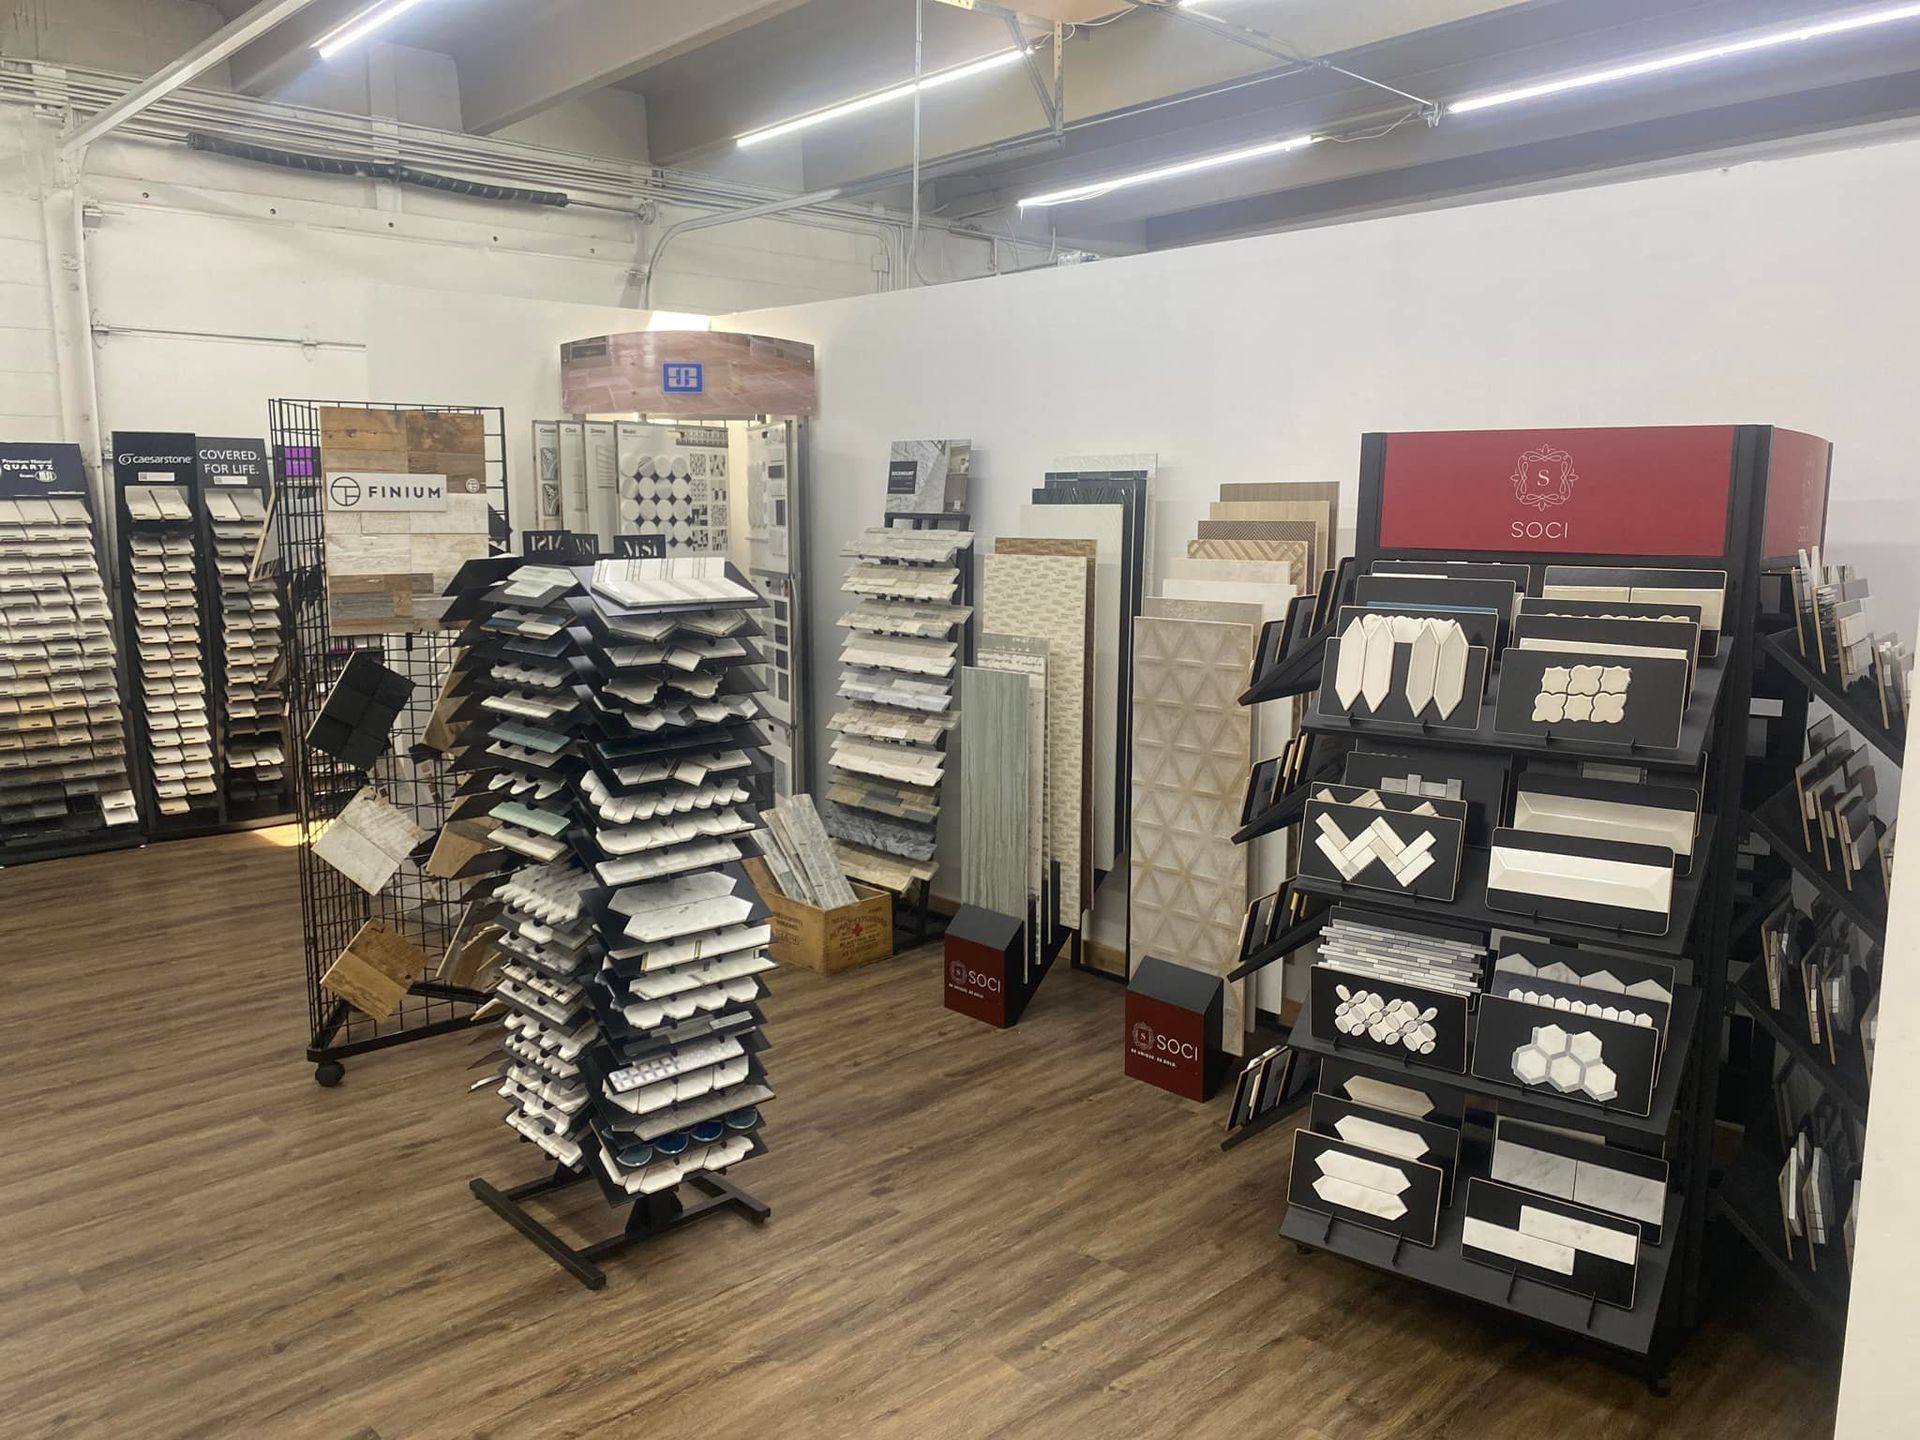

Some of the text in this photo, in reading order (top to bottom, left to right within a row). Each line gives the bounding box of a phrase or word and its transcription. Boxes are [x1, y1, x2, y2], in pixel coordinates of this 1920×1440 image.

[133, 453, 192, 464] caesarstone
[199, 449, 261, 461] COVERED.
[204, 463, 260, 475] FOR LIFE.
[368, 486, 441, 499] FINIUM
[1511, 521, 1568, 539] SOCI
[968, 970, 1001, 993] SOCI
[1156, 1034, 1198, 1062] SOCI
